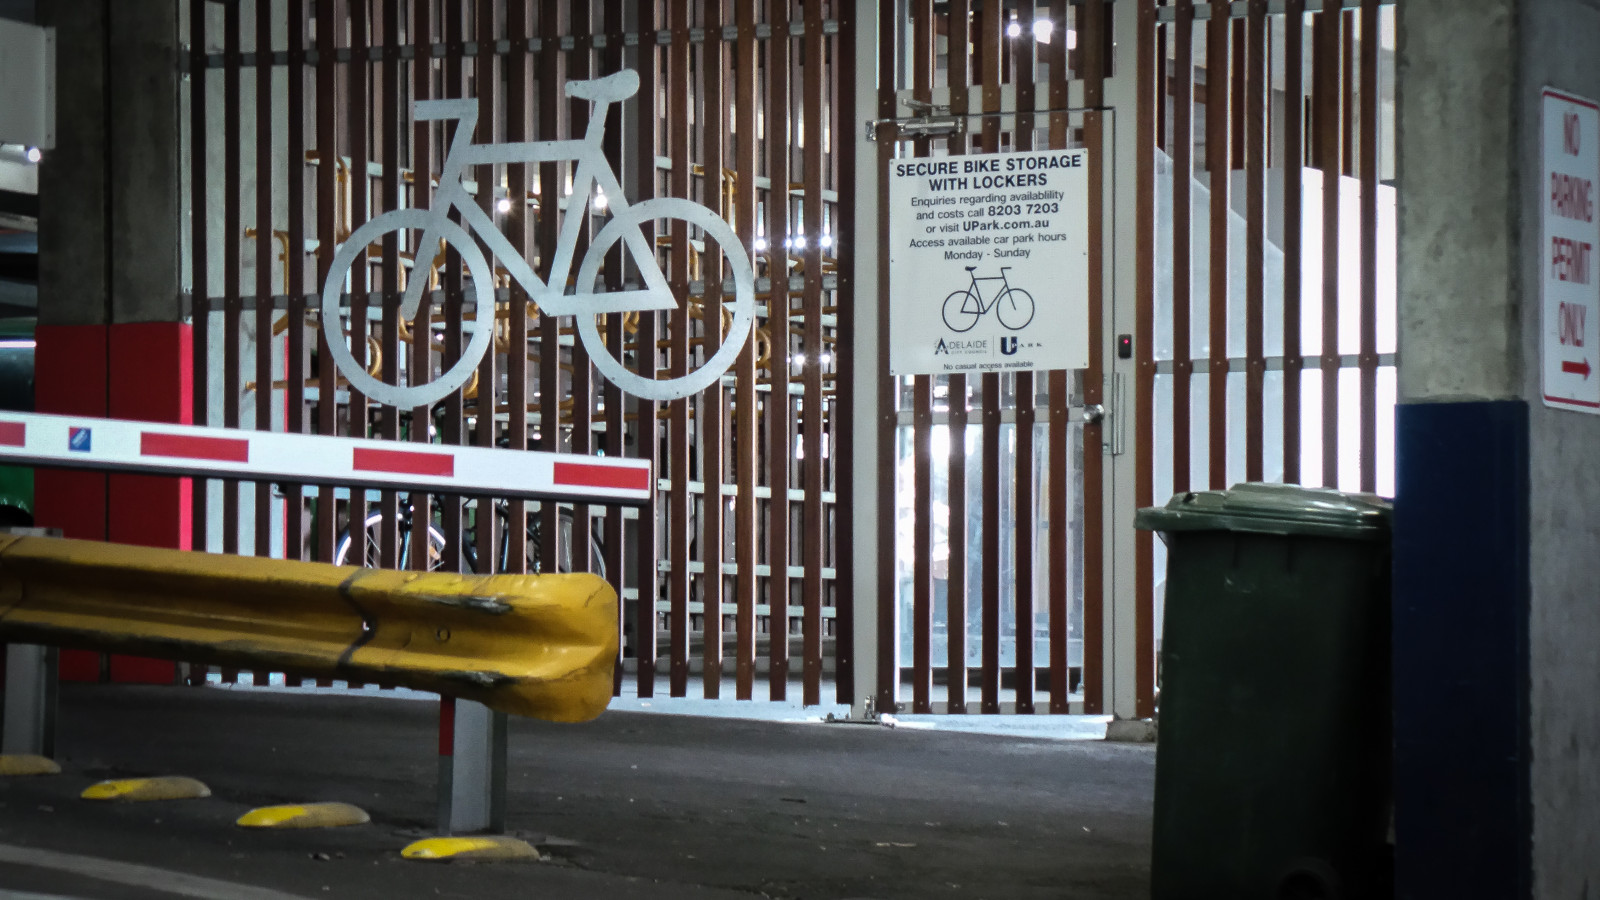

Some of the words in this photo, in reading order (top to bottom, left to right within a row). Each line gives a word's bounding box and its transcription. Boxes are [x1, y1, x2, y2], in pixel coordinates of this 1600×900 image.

[1563, 111, 1581, 156] NO
[896, 161, 958, 177] SECURE
[964, 159, 1000, 173] BIKE
[1006, 155, 1082, 171] STORAGE
[929, 177, 968, 191] WITH
[973, 173, 1047, 189] LOCKERS
[911, 196, 956, 207] Enquiries
[959, 194, 1006, 205] regarding
[1551, 172, 1593, 223] PARKING
[916, 211, 934, 219] and
[938, 209, 964, 219] costs
[967, 208, 984, 217] call
[988, 205, 1021, 217] 8203
[1026, 203, 1059, 214] 7203
[925, 224, 935, 233] or
[939, 223, 959, 232] visit
[963, 219, 1049, 231] UPark.com.au
[909, 238, 944, 248] Access
[948, 236, 990, 246] available
[994, 235, 1009, 244] car
[1013, 233, 1034, 245] park
[1038, 232, 1066, 241] hours
[944, 250, 983, 261] Monday
[994, 248, 1031, 259] Sunday
[1551, 236, 1591, 285] PERMIT
[1559, 301, 1586, 347] ONLY
[935, 338, 987, 355] ADELAIDE
